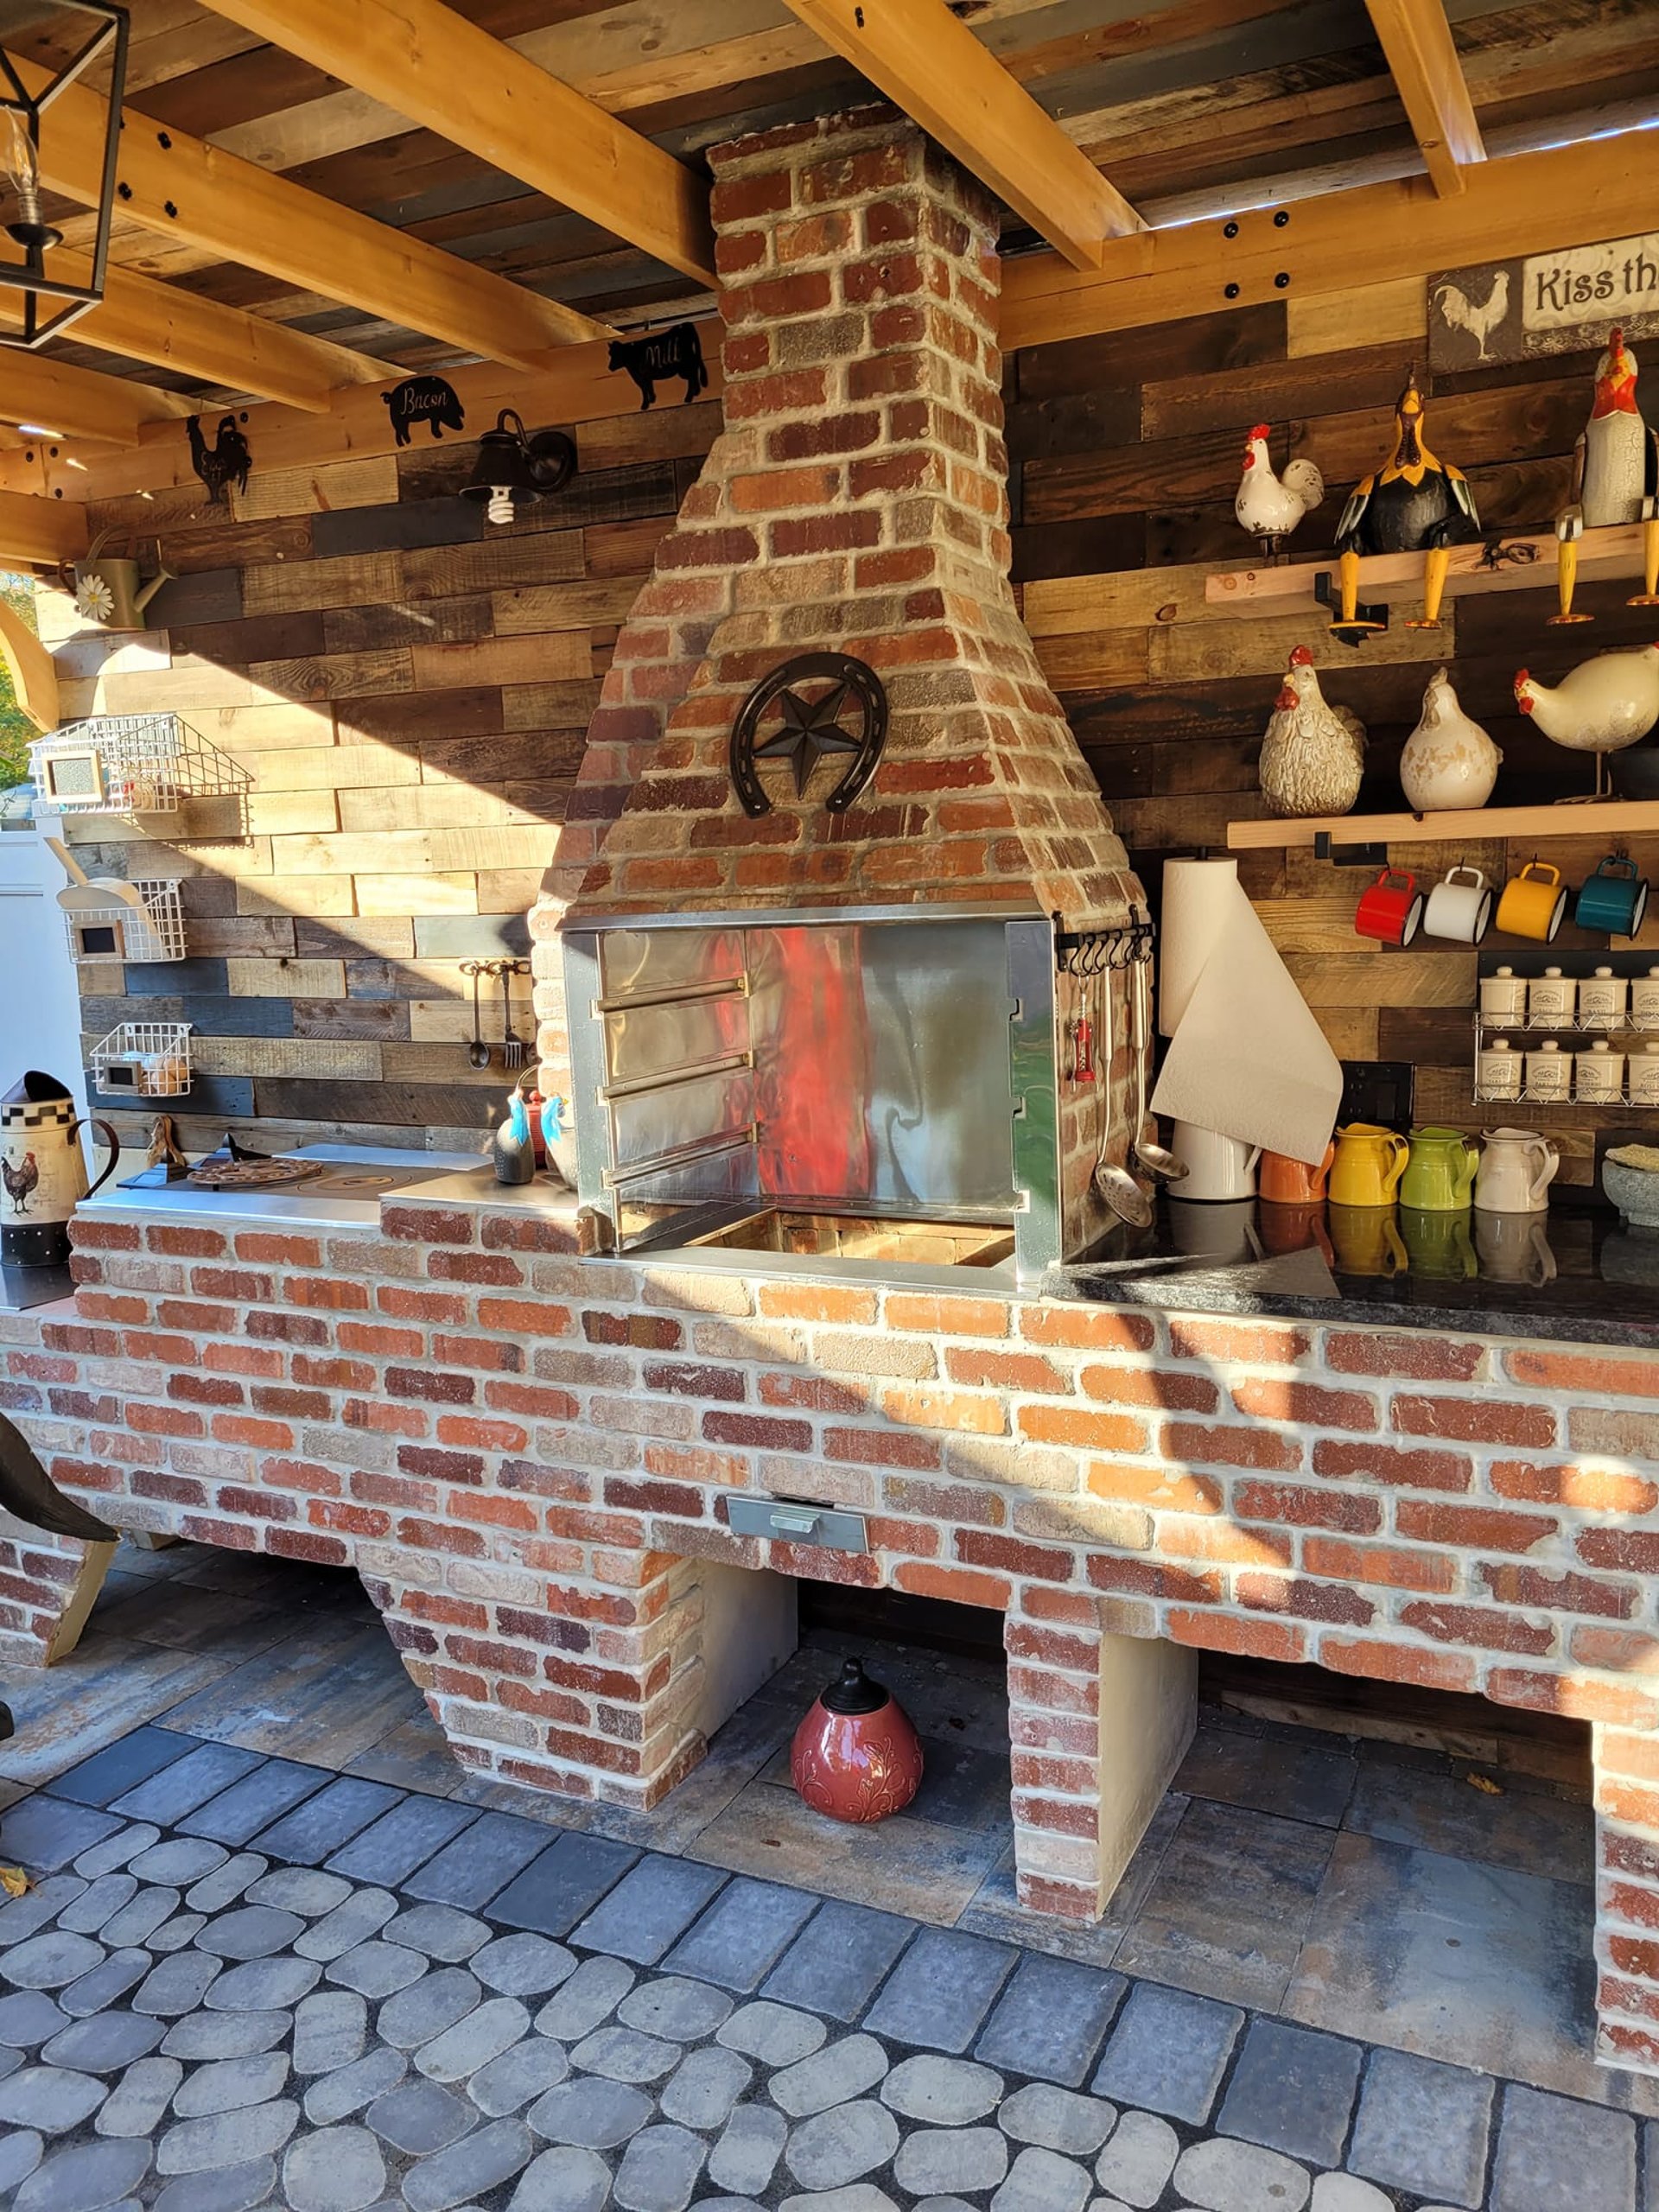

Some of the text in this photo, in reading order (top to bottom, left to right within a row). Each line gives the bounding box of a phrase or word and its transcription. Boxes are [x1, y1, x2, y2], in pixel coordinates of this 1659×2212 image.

[1536, 251, 1659, 311] Kiss th
[400, 386, 448, 416] Bacon
